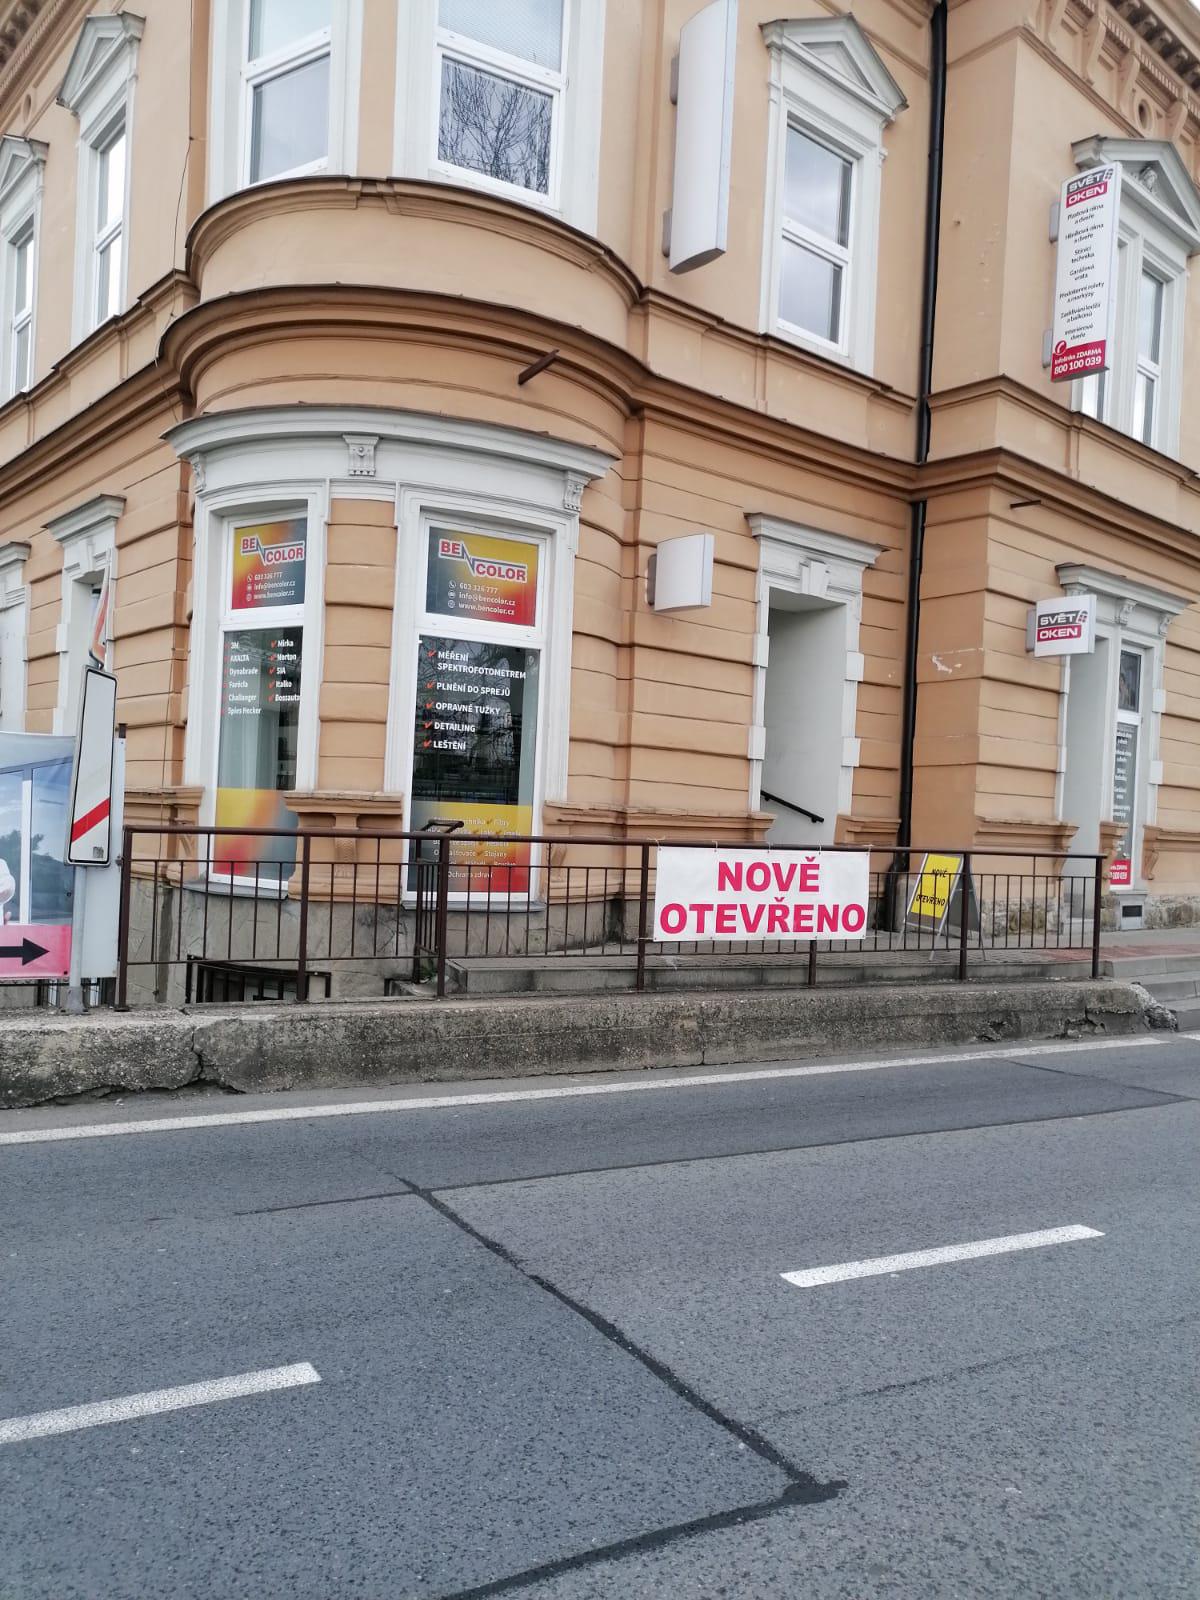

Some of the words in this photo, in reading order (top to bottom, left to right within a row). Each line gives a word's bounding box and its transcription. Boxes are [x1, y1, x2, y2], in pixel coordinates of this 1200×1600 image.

[1069, 172, 1103, 192] SVĚT
[1068, 185, 1105, 205] OKEN
[1076, 348, 1102, 359] ZDARMA
[1054, 363, 1068, 375] 800
[1069, 359, 1084, 370] 100
[1085, 355, 1102, 367] 039
[266, 547, 304, 563] COLOR
[475, 562, 526, 582] COLOR
[459, 591, 516, 606] info@bencolor.cz
[458, 602, 515, 616] www.bencolor.cz
[1040, 611, 1076, 626] SVĚT
[1039, 627, 1078, 639] OKEN
[277, 639, 294, 648] Mirka
[438, 651, 469, 662] MĚŘENÍ
[437, 663, 526, 680] SPEKTROFOTOMETREM
[436, 682, 466, 692] PLNĚNÍ
[467, 685, 479, 694] DO
[480, 687, 511, 697] SPREJŮ
[436, 702, 473, 713] OPRAVNÉ
[474, 705, 501, 715] TUŽKY
[434, 721, 476, 732] DETAILING
[433, 740, 466, 750] LEŠTĚNÍ
[717, 856, 820, 893] NOVĚ
[659, 896, 866, 935] OTEVŘENO
